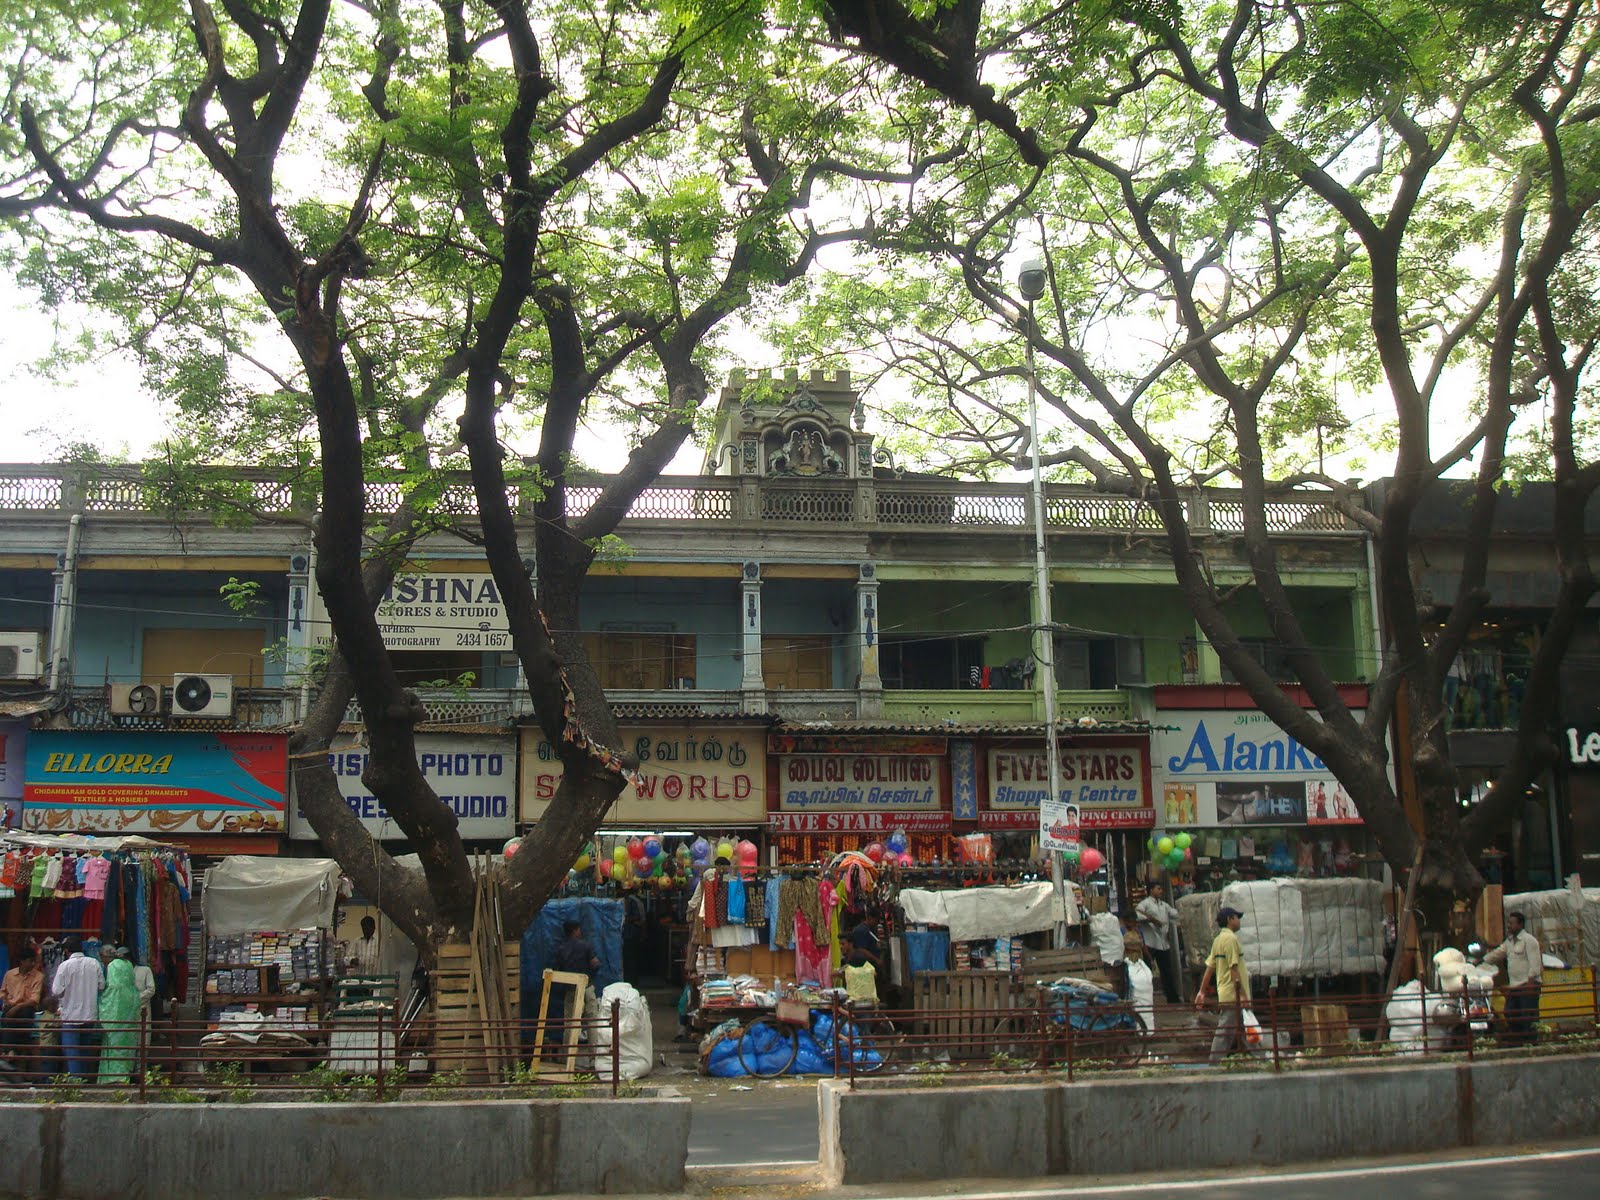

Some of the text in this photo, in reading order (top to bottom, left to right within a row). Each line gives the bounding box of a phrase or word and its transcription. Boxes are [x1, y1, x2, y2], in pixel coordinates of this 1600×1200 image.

[382, 578, 501, 604] ISHNA
[378, 607, 498, 617] STORES & STUDIO
[456, 634, 508, 646] 2434 1657
[44, 753, 174, 775] ELLORRA
[421, 753, 503, 776] PHOTO
[996, 755, 1134, 781] FIVE STARS
[636, 774, 752, 800] WORLD
[1078, 785, 1137, 802] Centre
[769, 814, 883, 830] FIVE STAR
[981, 813, 1008, 822] FIVE
[1111, 811, 1154, 820] CENTRE
